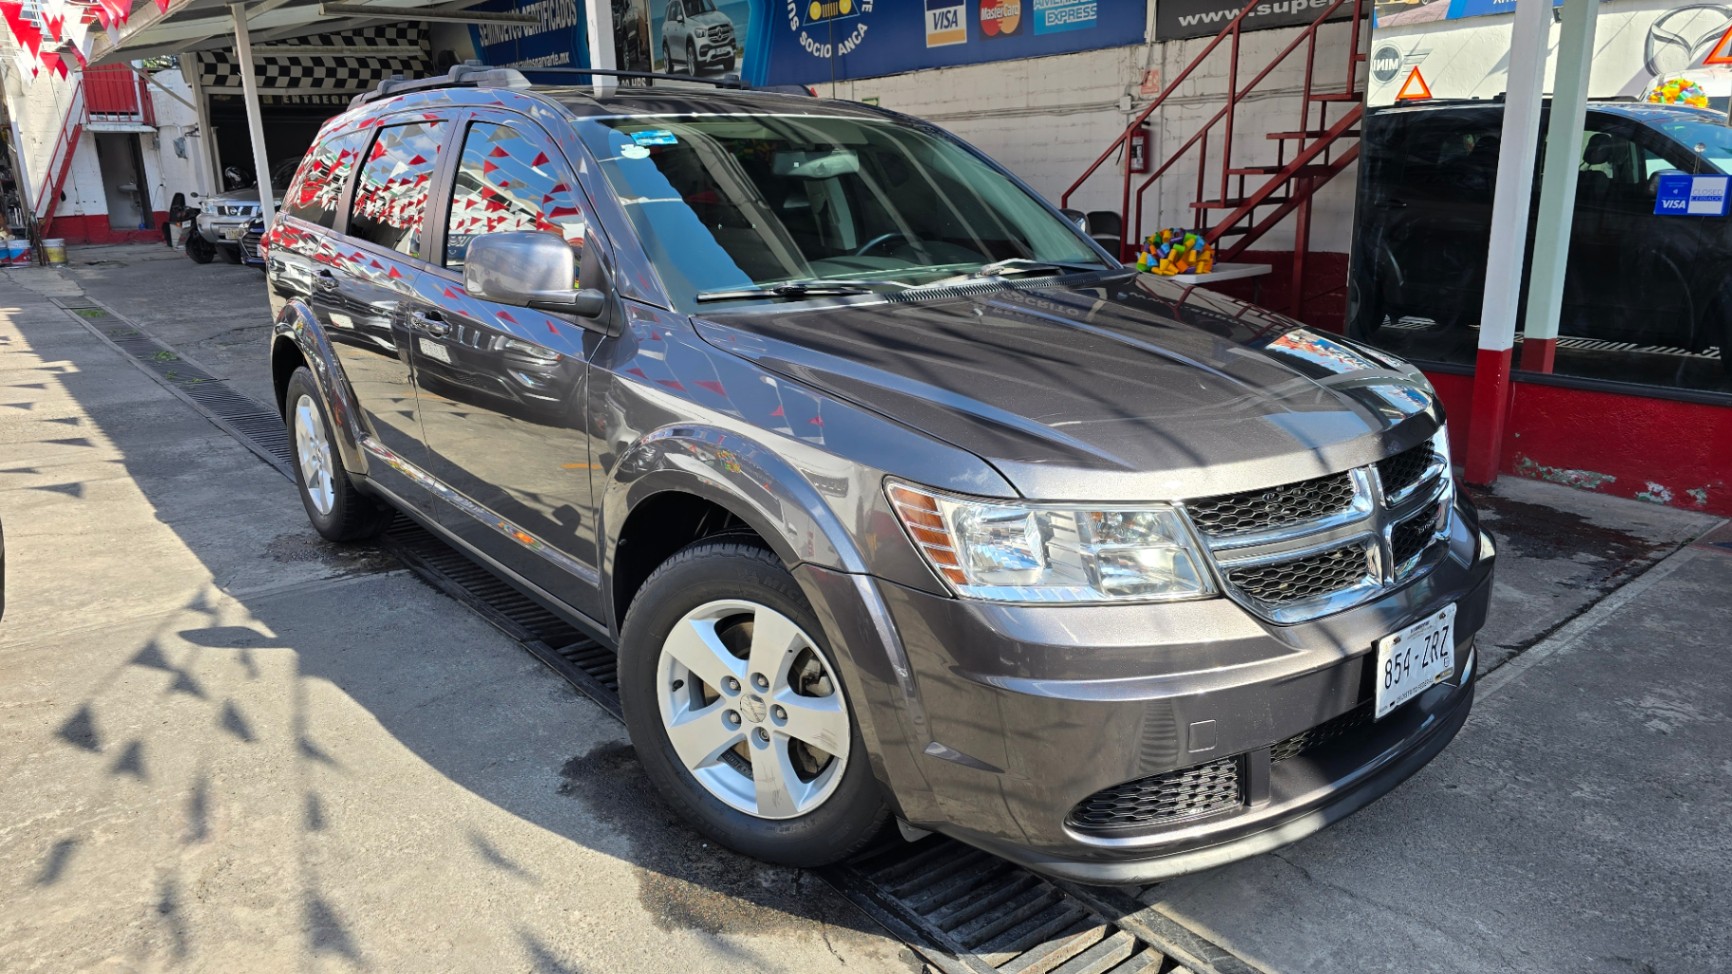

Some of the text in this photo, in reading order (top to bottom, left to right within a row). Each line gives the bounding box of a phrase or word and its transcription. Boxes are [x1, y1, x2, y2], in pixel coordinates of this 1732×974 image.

[932, 9, 958, 30] VISA
[980, 6, 1020, 21] MasterCard
[1045, 3, 1097, 26] EXPRESS
[800, 23, 868, 58] SOCIO ANCA
[1662, 200, 1686, 209] VISA
